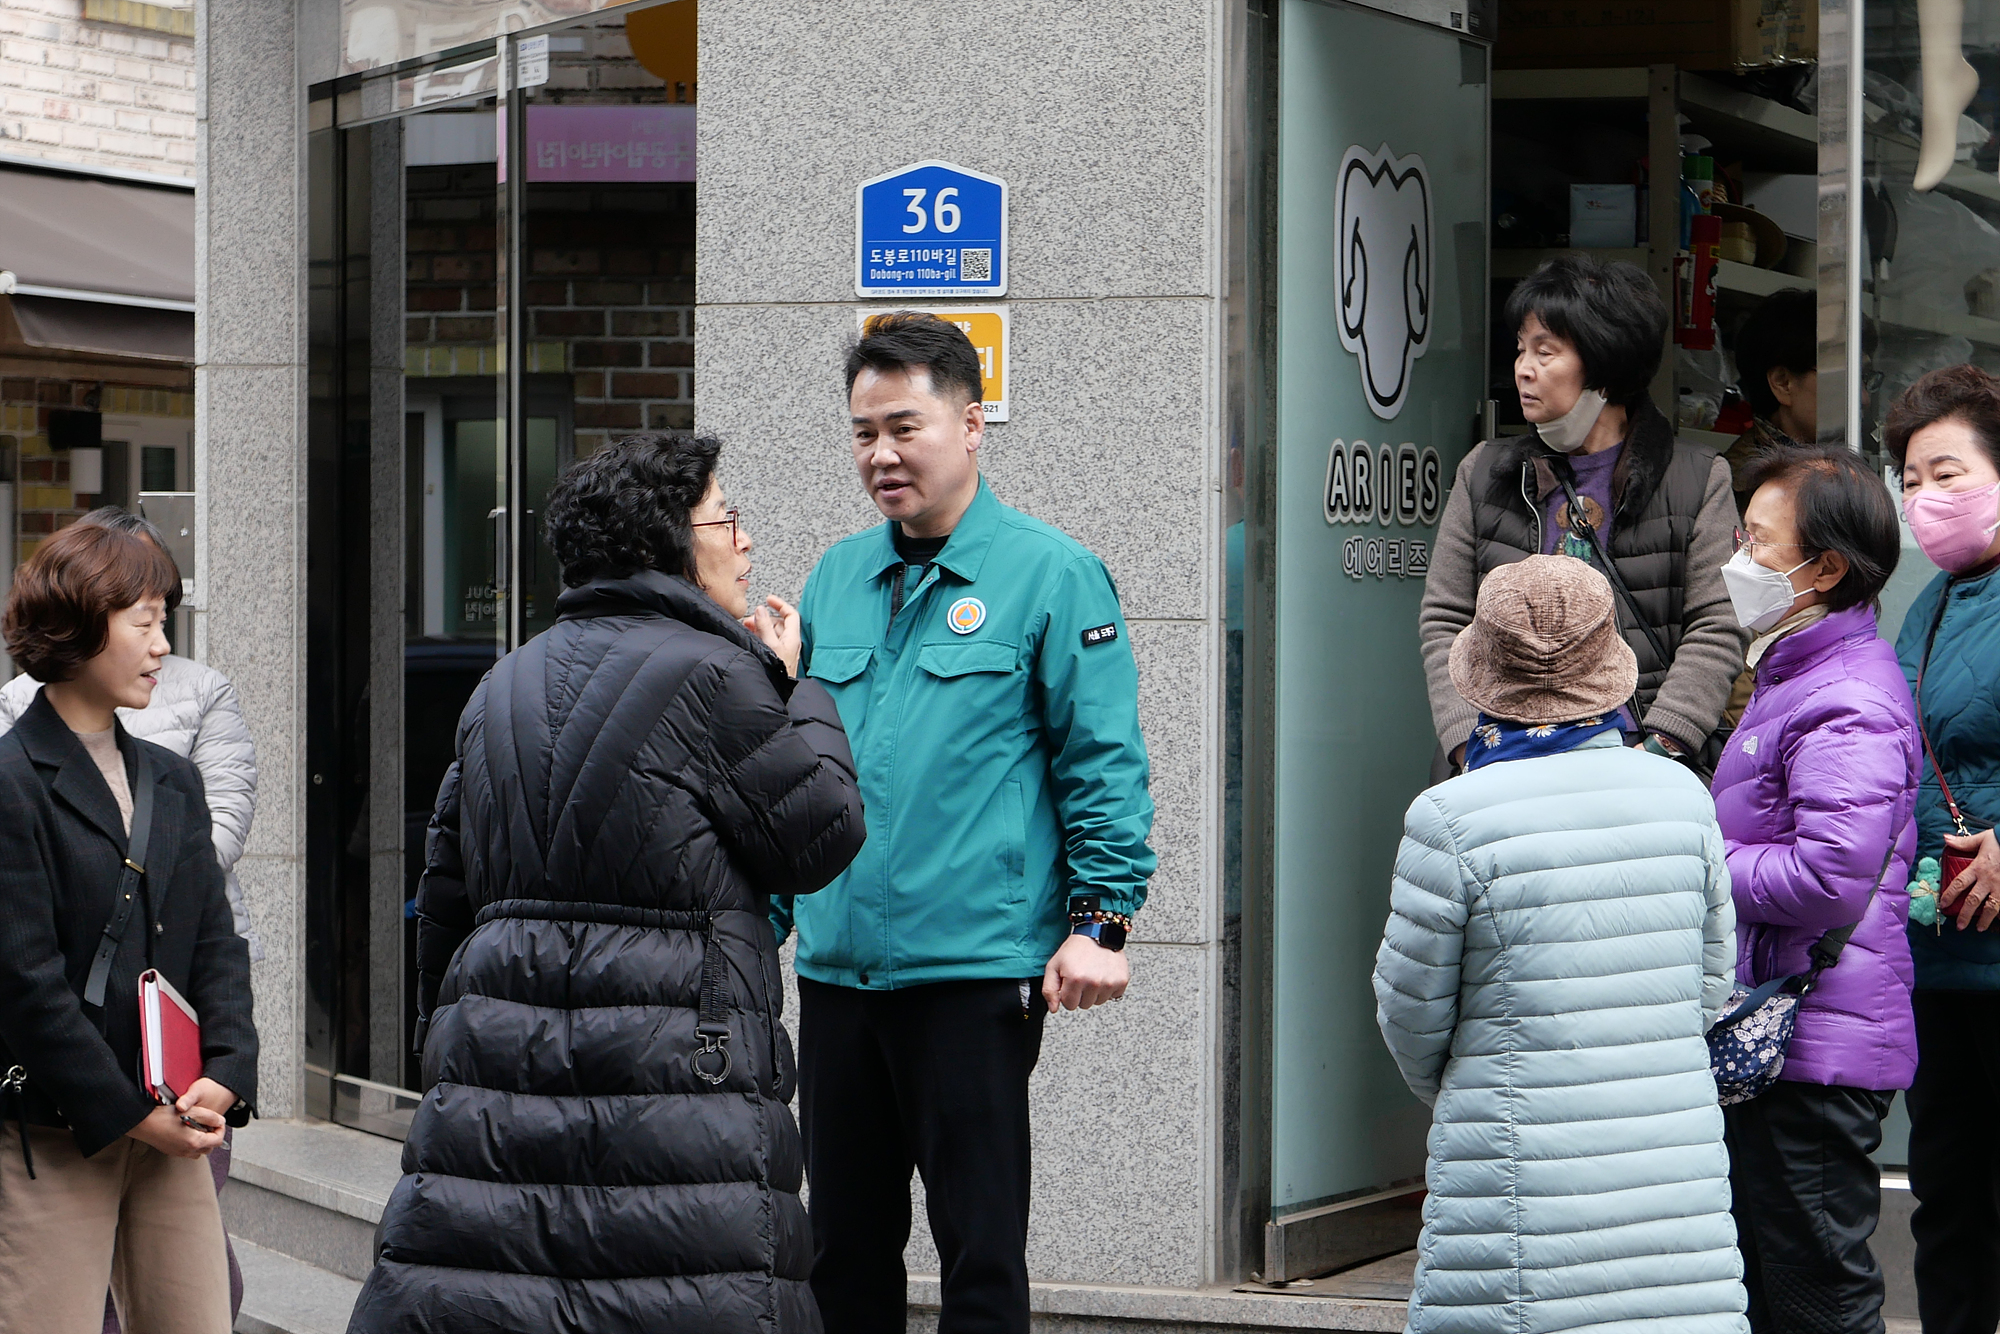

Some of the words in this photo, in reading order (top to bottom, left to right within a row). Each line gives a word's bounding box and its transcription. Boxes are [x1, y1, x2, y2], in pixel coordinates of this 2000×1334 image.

[902, 187, 962, 234] 36
[870, 248, 957, 266] 도봉로110바길
[870, 268, 914, 281] Dobong-ro
[917, 268, 956, 281] 110ba-gil
[1327, 445, 1441, 520] ARIES
[1343, 536, 1428, 577] 에어리즈
